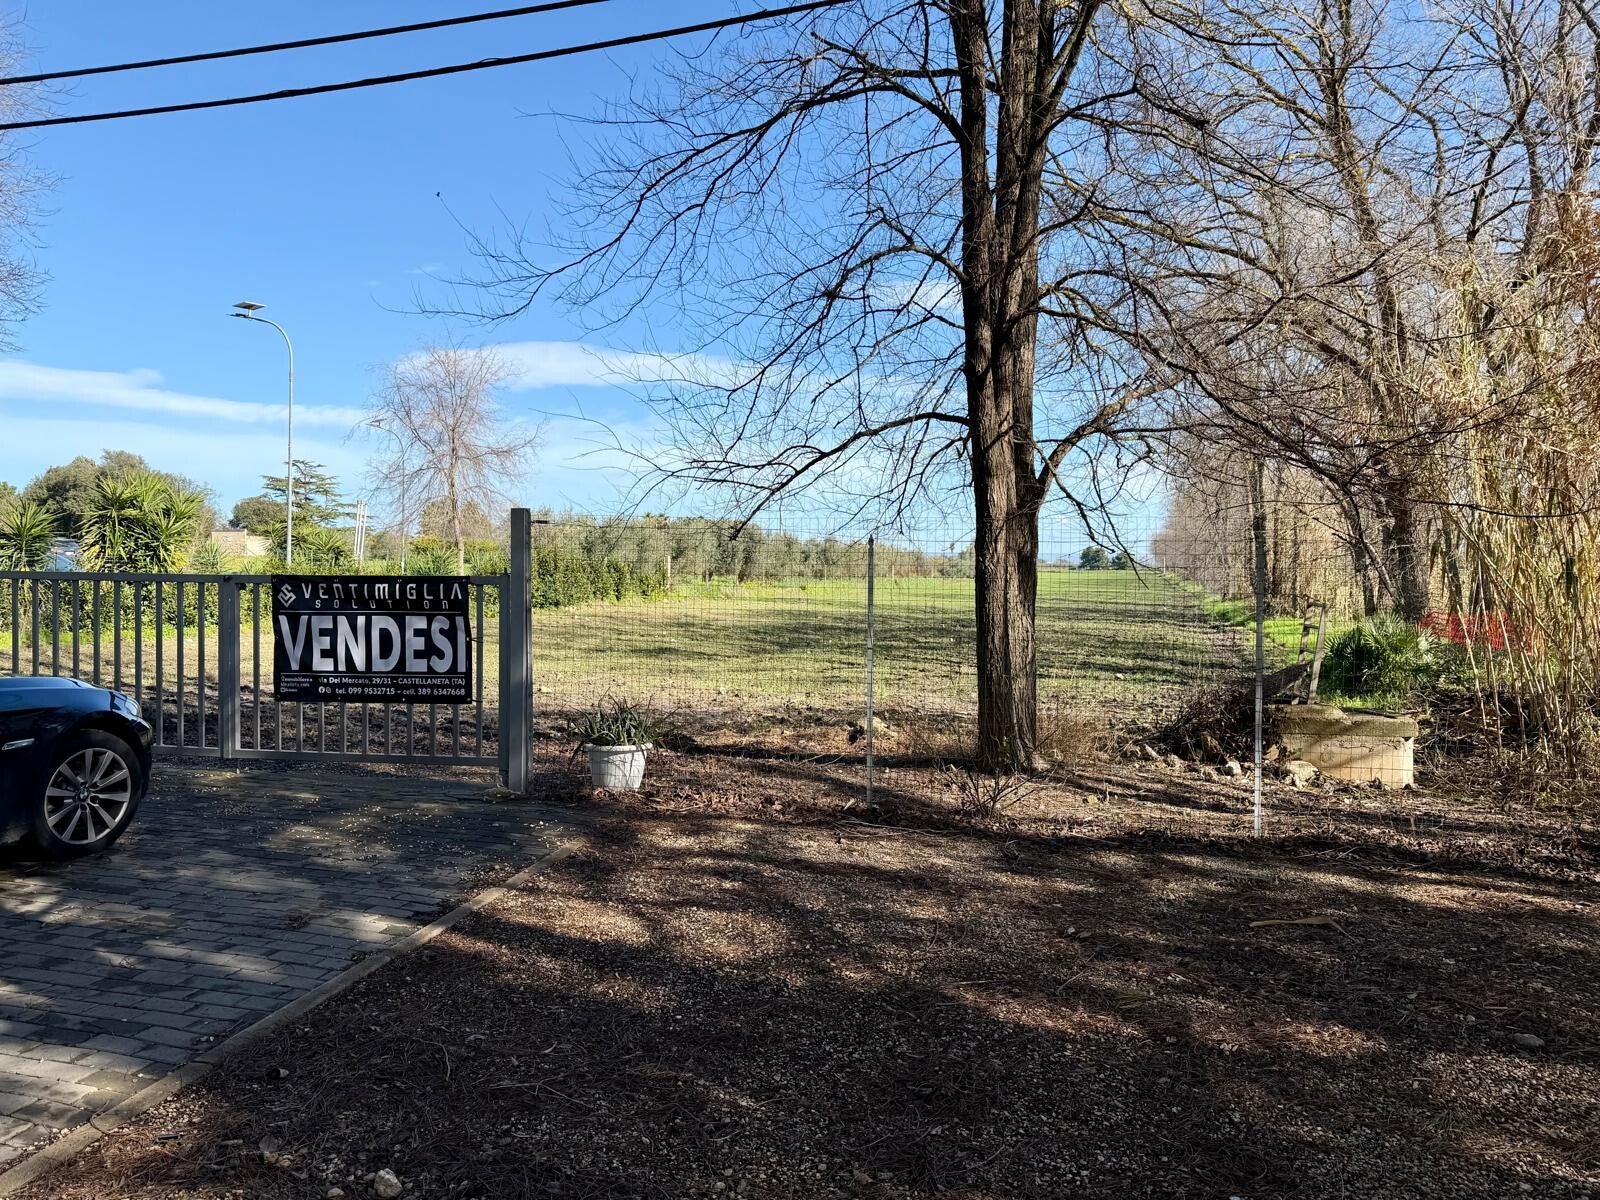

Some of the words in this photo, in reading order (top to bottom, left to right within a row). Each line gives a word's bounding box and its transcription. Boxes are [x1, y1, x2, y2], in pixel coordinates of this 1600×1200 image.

[302, 583, 462, 600] VENTIMIGLIA
[315, 599, 449, 610] SOLUTION
[278, 615, 466, 673] VENDESI
[342, 677, 371, 685] Mercato,
[451, 678, 465, 686] (TA)
[364, 687, 395, 695] 9532715
